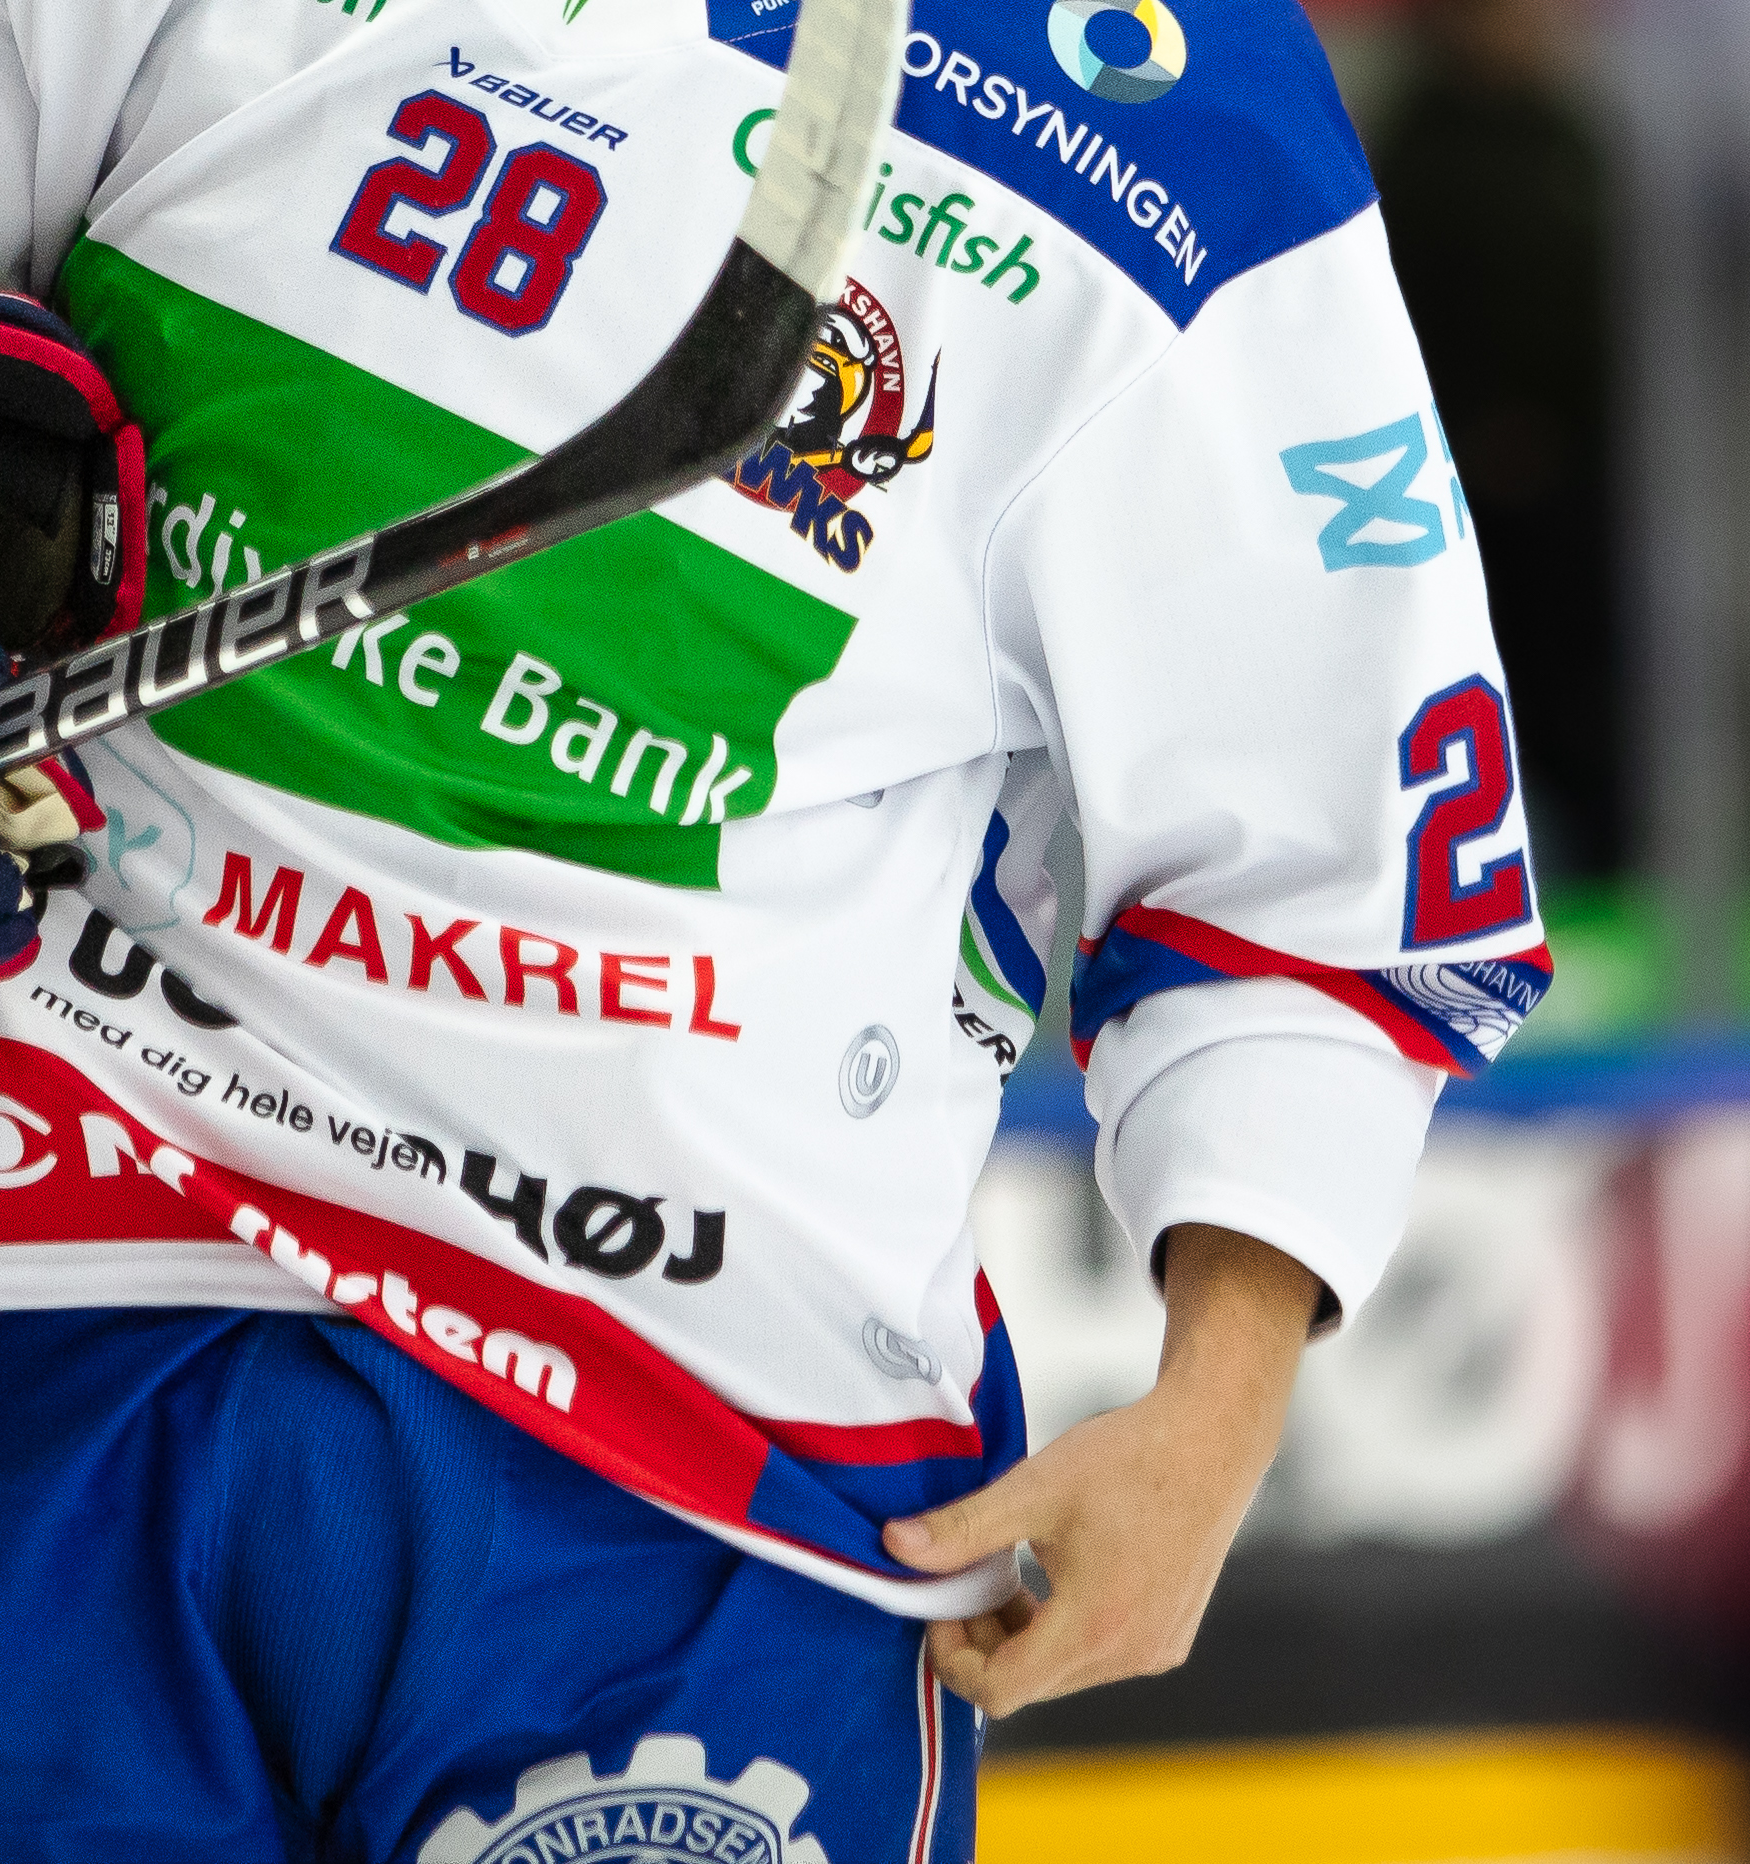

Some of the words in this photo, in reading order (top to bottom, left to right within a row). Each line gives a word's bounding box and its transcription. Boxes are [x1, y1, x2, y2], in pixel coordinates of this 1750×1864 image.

[328, 88, 609, 339] 28
[731, 107, 1042, 305] Cisfish
[899, 30, 1210, 287] ORSYNINGEN
[479, 650, 753, 826] Bank
[201, 850, 744, 1043] MAKREL
[30, 985, 133, 1050] med
[140, 1047, 212, 1096] dig
[220, 1071, 314, 1133] hele
